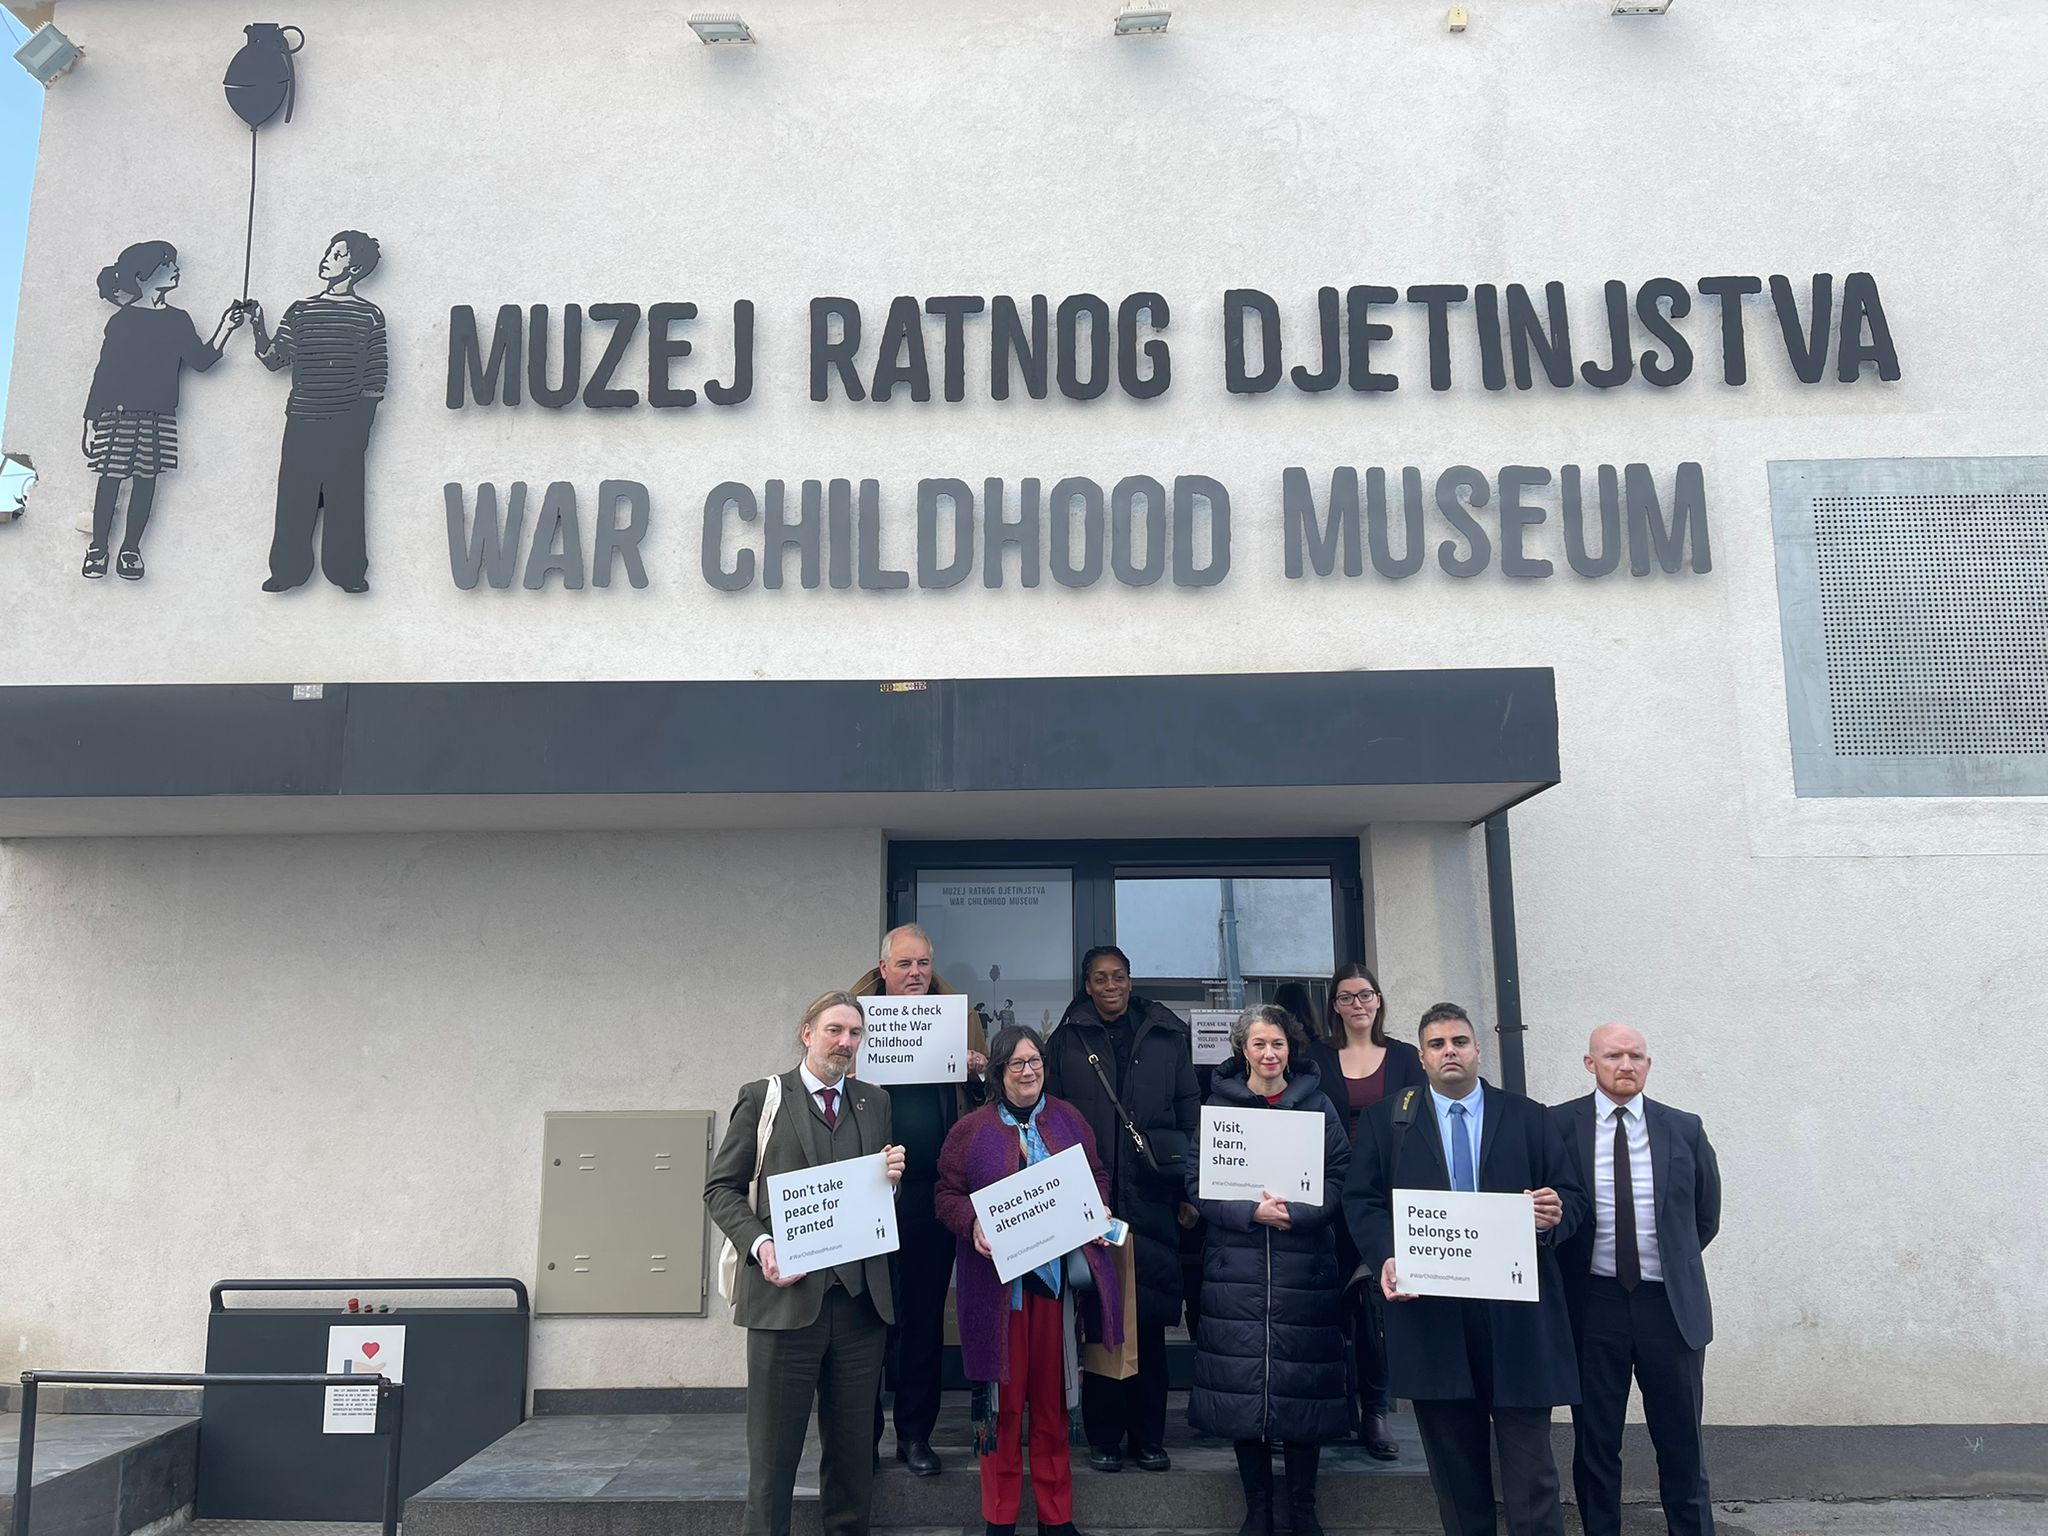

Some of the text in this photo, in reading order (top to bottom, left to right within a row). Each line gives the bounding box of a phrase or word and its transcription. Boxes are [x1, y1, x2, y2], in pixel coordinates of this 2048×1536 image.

[446, 272, 1902, 409] MUZEJ RATNOG DJETINJSTVA
[443, 462, 1712, 591] WAR CHILDHOOD MUSEUM
[942, 886, 1046, 895] MUZEJ RATNOG DJETINJSTVA
[949, 897, 1039, 906] WAR CHILDHOOD MUSEUM
[868, 1004, 942, 1016] Come & check
[868, 1021, 933, 1032] out the War
[868, 1036, 923, 1048] Childhood
[868, 1053, 914, 1064] Museum
[1213, 1121, 1244, 1135] Visit,
[1212, 1137, 1246, 1151] learn,
[1212, 1154, 1249, 1167] share.
[782, 1179, 844, 1201] Don't take
[988, 1177, 1061, 1217] Peace has no
[784, 1198, 840, 1222] peace for
[994, 1197, 1057, 1233] alternative
[1408, 1206, 1447, 1219] Peace
[786, 1215, 834, 1241] granted
[1408, 1224, 1479, 1242] belongs to
[1409, 1245, 1472, 1260] everyone
[1409, 1272, 1471, 1282] #WarChildhoodMuseum
